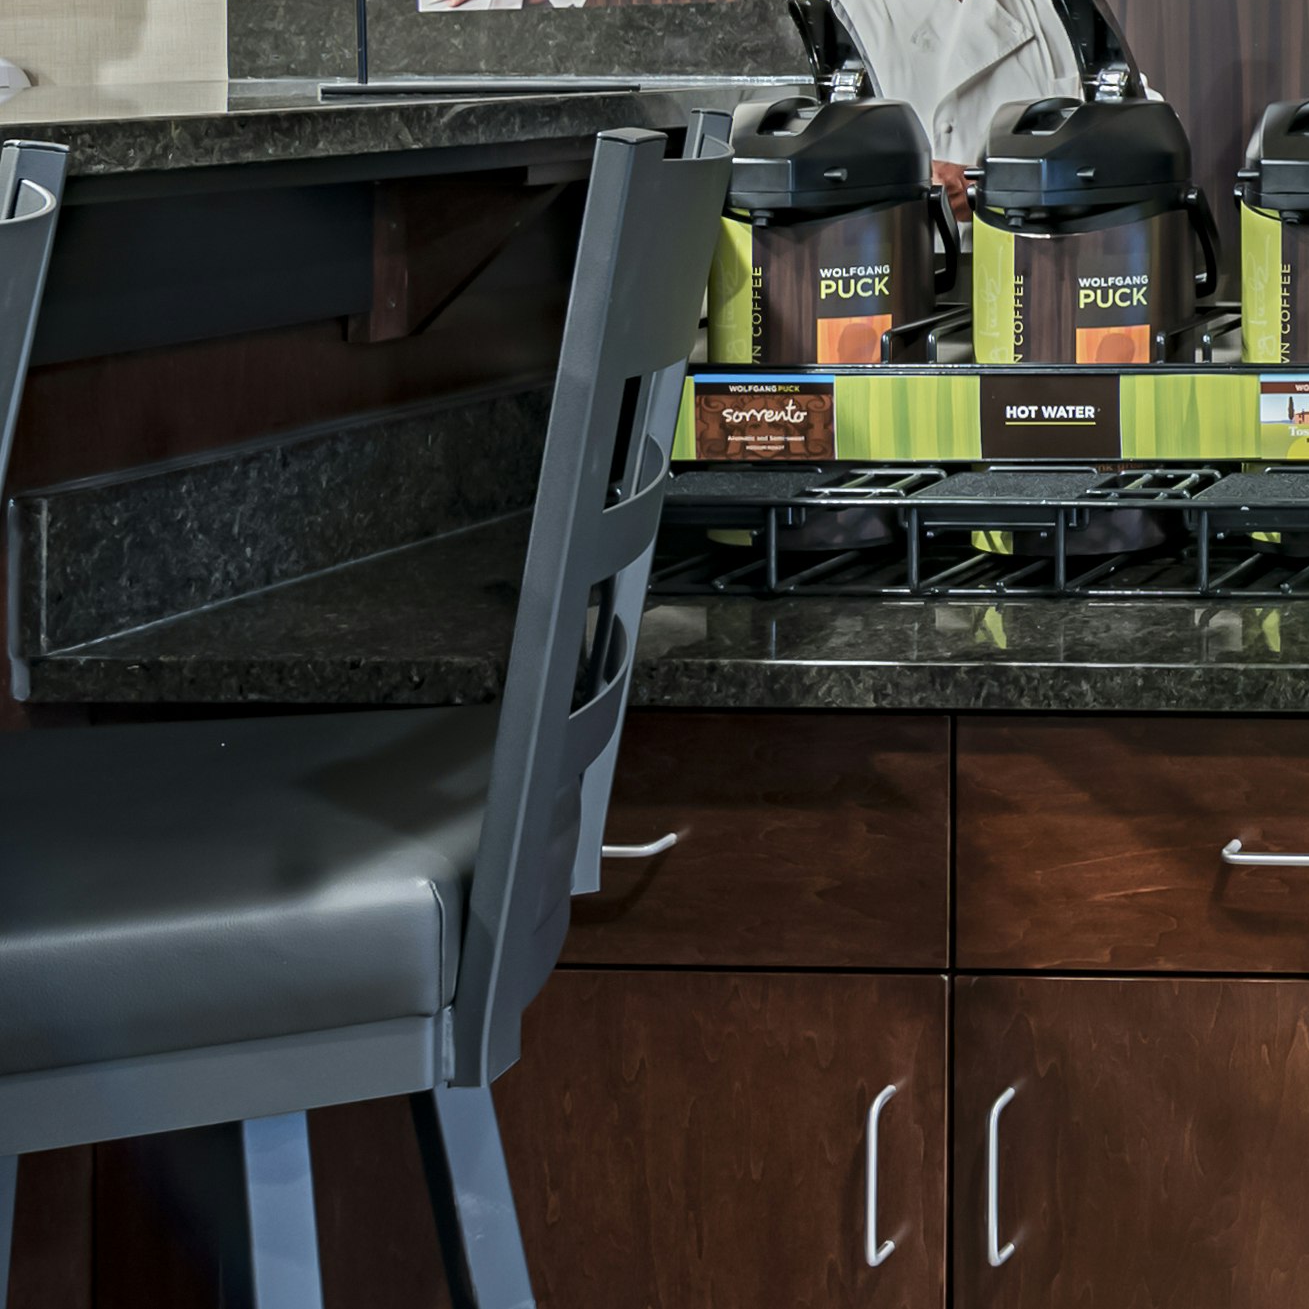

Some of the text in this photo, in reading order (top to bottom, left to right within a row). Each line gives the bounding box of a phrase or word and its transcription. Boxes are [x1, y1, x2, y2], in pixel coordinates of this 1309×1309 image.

[819, 264, 890, 278] WOLFGANG
[1078, 274, 1149, 288] WOLFGANG
[820, 276, 890, 300] PUCK
[1079, 286, 1148, 309] PUCK
[1280, 263, 1291, 335] COFFEE
[752, 266, 762, 337] COFFEE
[1014, 275, 1024, 346] COFFEE
[721, 398, 808, 424] sorrento
[1005, 405, 1095, 419] HOT WATER
